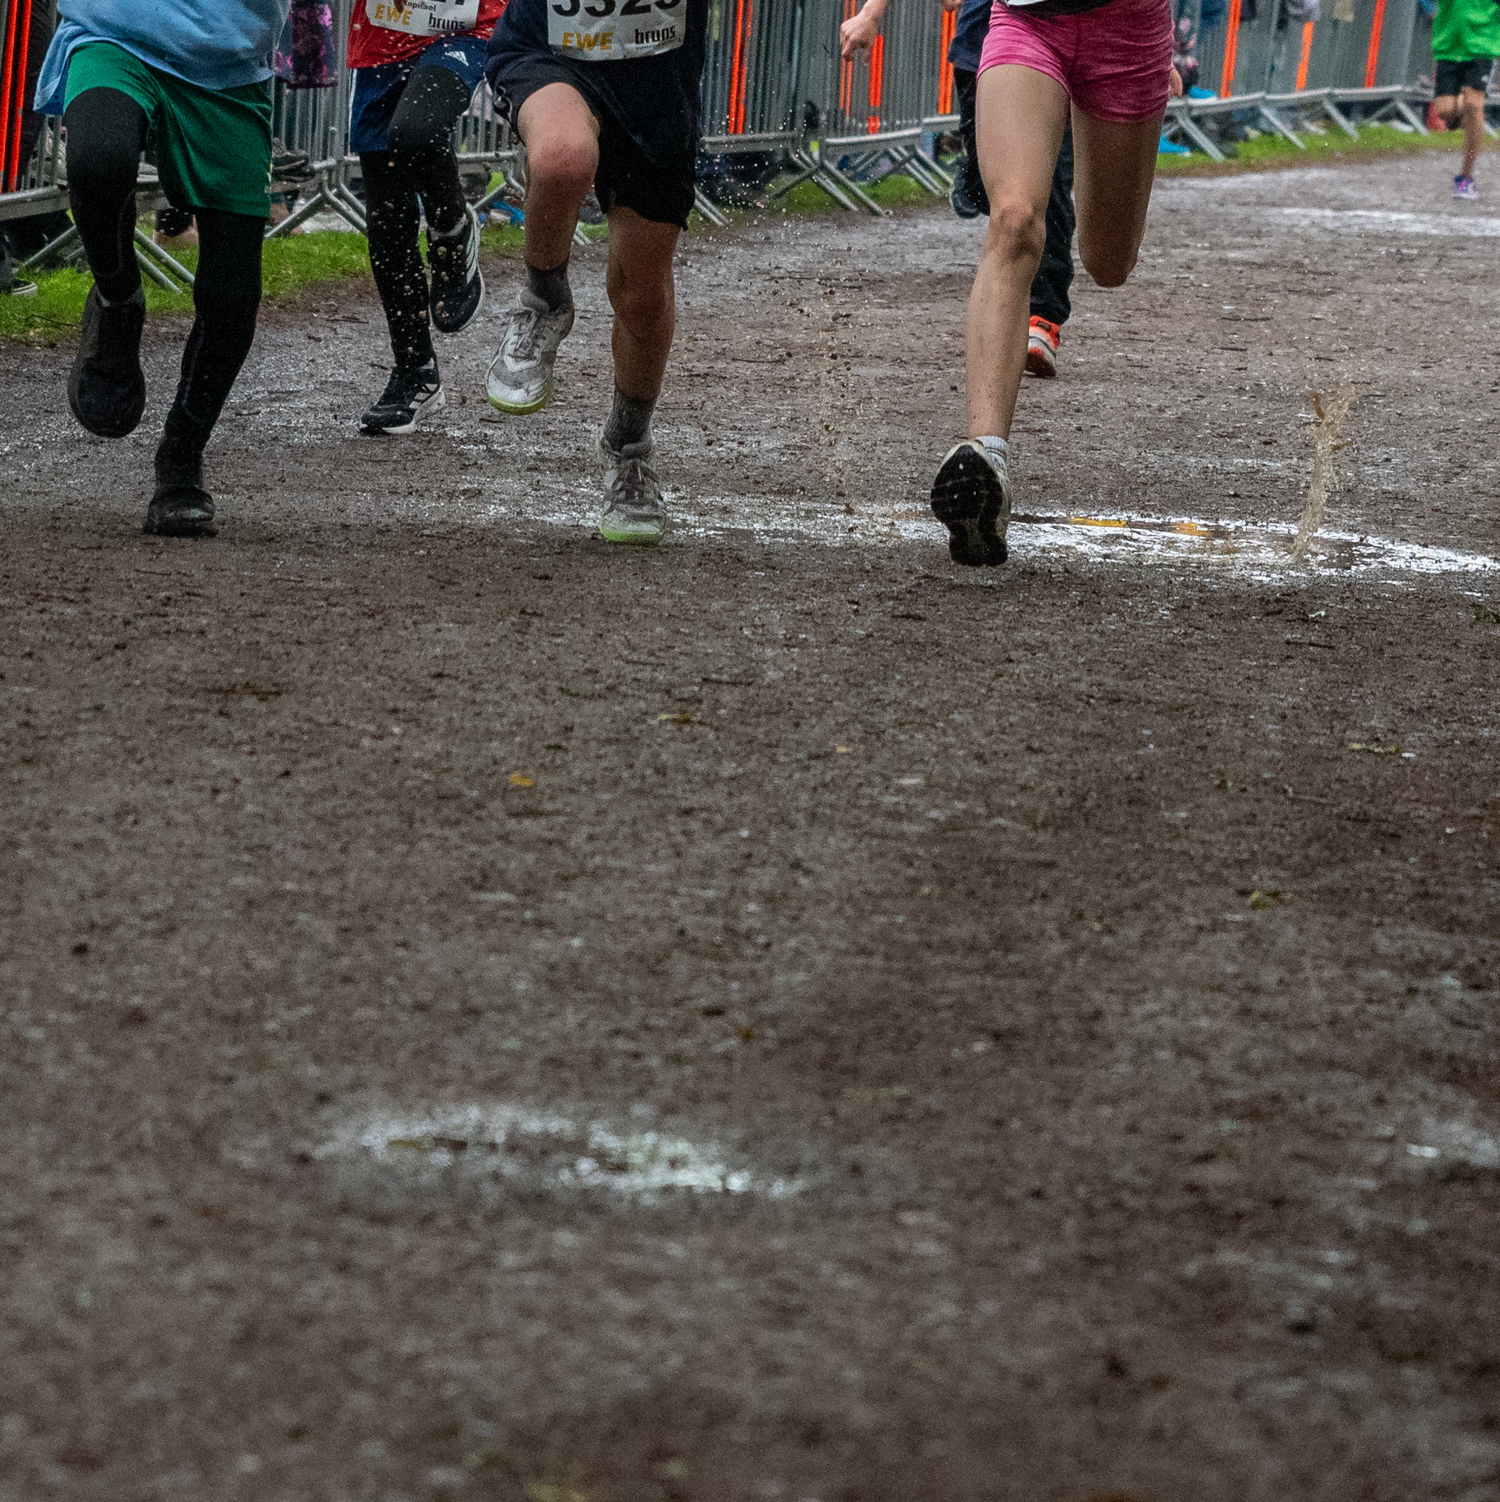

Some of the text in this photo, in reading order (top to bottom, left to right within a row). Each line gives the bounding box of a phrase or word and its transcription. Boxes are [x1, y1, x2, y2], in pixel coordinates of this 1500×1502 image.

[375, 3, 412, 26] EWE
[405, 1, 436, 11] aphael
[428, 13, 466, 31] bruns
[562, 31, 613, 51] EWE
[634, 25, 676, 45] bruns
